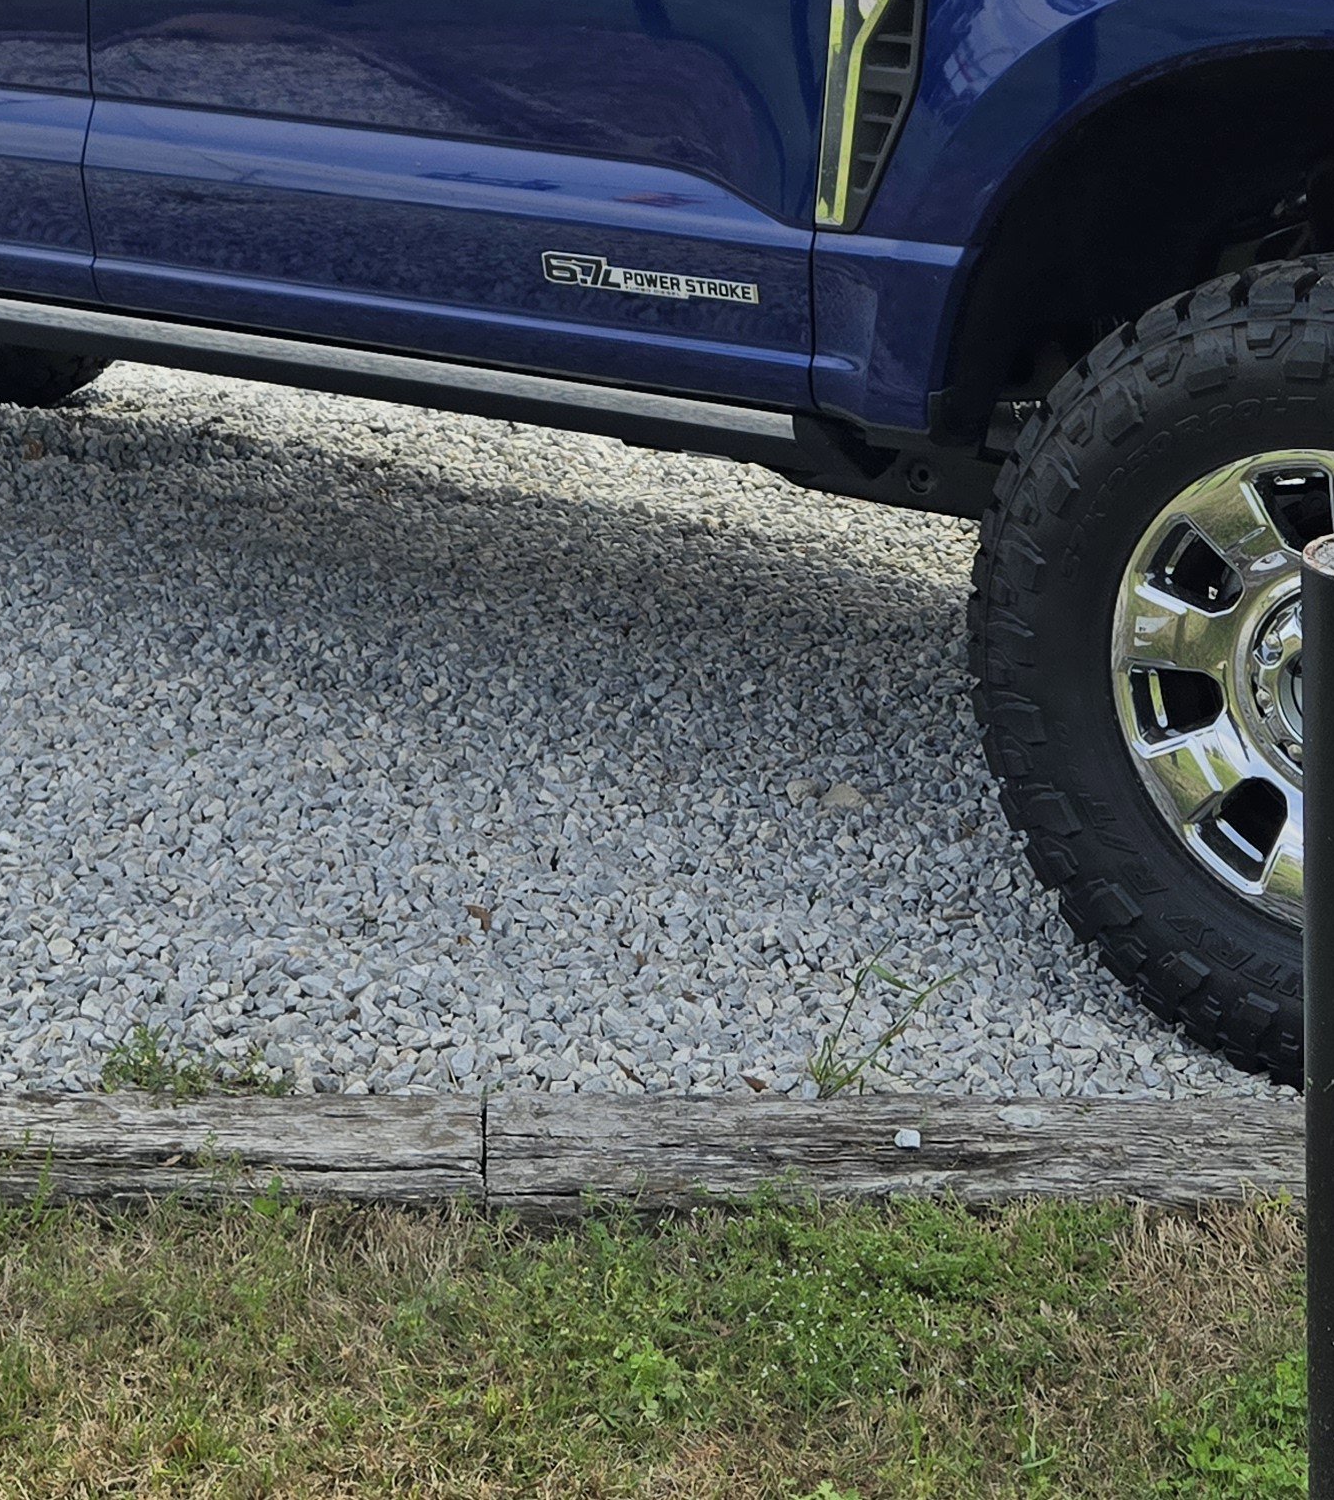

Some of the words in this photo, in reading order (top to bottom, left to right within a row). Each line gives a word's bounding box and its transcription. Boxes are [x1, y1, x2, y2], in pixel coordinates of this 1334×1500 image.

[542, 251, 621, 289] 6.7L
[623, 270, 681, 292] POWER
[685, 279, 752, 301] STROKE
